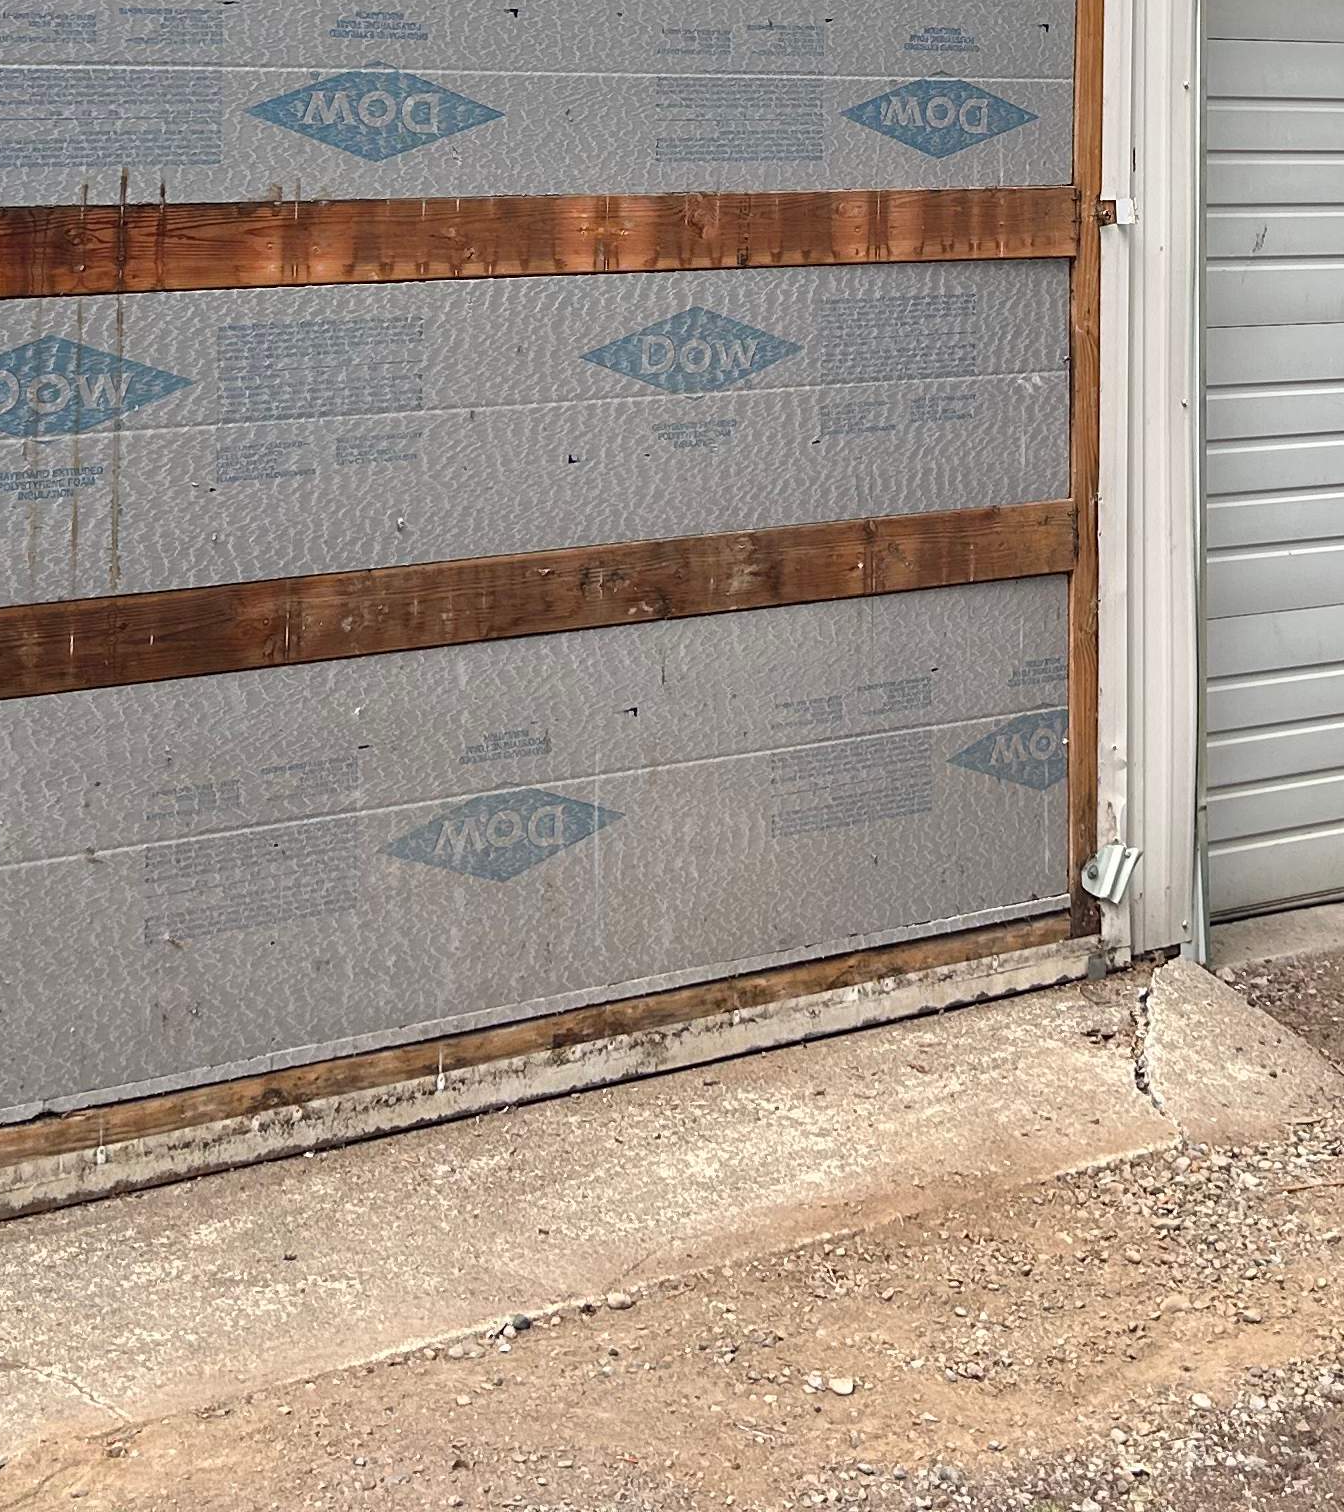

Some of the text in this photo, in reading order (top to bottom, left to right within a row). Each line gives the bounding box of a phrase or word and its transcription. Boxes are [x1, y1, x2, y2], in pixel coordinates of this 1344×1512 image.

[303, 90, 442, 135] DOW
[881, 97, 989, 135] DOW
[639, 334, 760, 376] DOW
[990, 726, 1067, 766] OW
[433, 805, 565, 855] DOW
